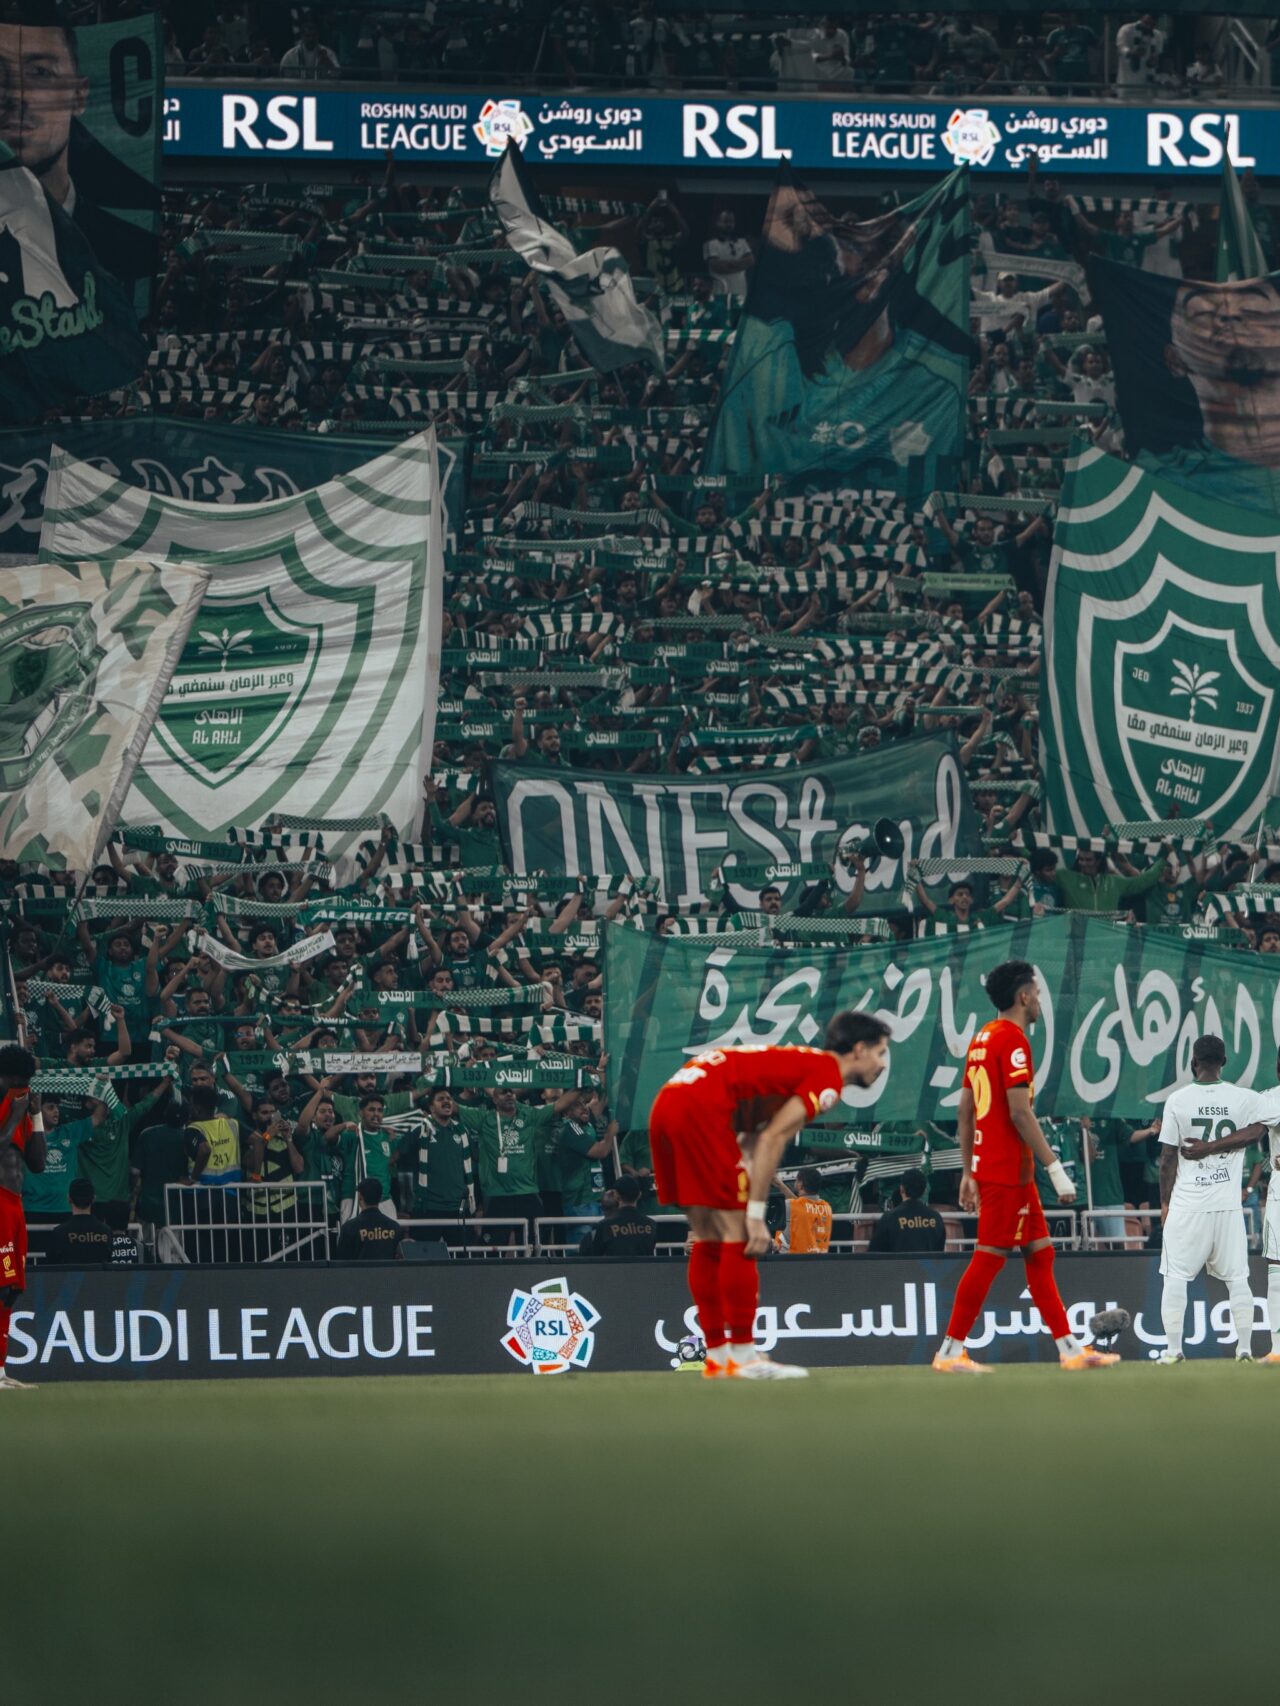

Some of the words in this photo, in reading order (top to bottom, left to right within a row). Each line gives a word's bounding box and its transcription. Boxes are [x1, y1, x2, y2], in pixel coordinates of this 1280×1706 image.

[361, 103, 415, 118] ROSHN
[420, 104, 467, 119] SAUDI
[539, 102, 592, 124] روشن
[600, 107, 642, 127] دوري
[833, 112, 887, 128] ROSHN
[895, 113, 936, 129] SAUDI
[222, 95, 333, 151] RSL
[683, 104, 792, 159] RSL
[1006, 111, 1057, 133] روشن
[1062, 116, 1107, 135] دوري
[361, 123, 467, 150] LEAGUE
[539, 130, 642, 158] السعودي
[833, 131, 936, 160] LEAGUE
[1147, 113, 1255, 167] RSL
[1006, 138, 1107, 168] السعودي
[1236, 701, 1254, 715] 1937
[192, 730, 210, 744] AL
[212, 730, 241, 744] AHLI
[1156, 778, 1172, 796] AL
[1174, 784, 1200, 805] AHLI
[1198, 1106, 1229, 1116] KESSIE
[611, 1224, 653, 1237] Police
[899, 1217, 936, 1229] Police
[68, 1233, 108, 1243] Police
[359, 1228, 396, 1241] Police
[6, 1310, 189, 1364] SAUDI
[209, 1304, 436, 1361] LEAGUE
[534, 1319, 567, 1337] RSL
